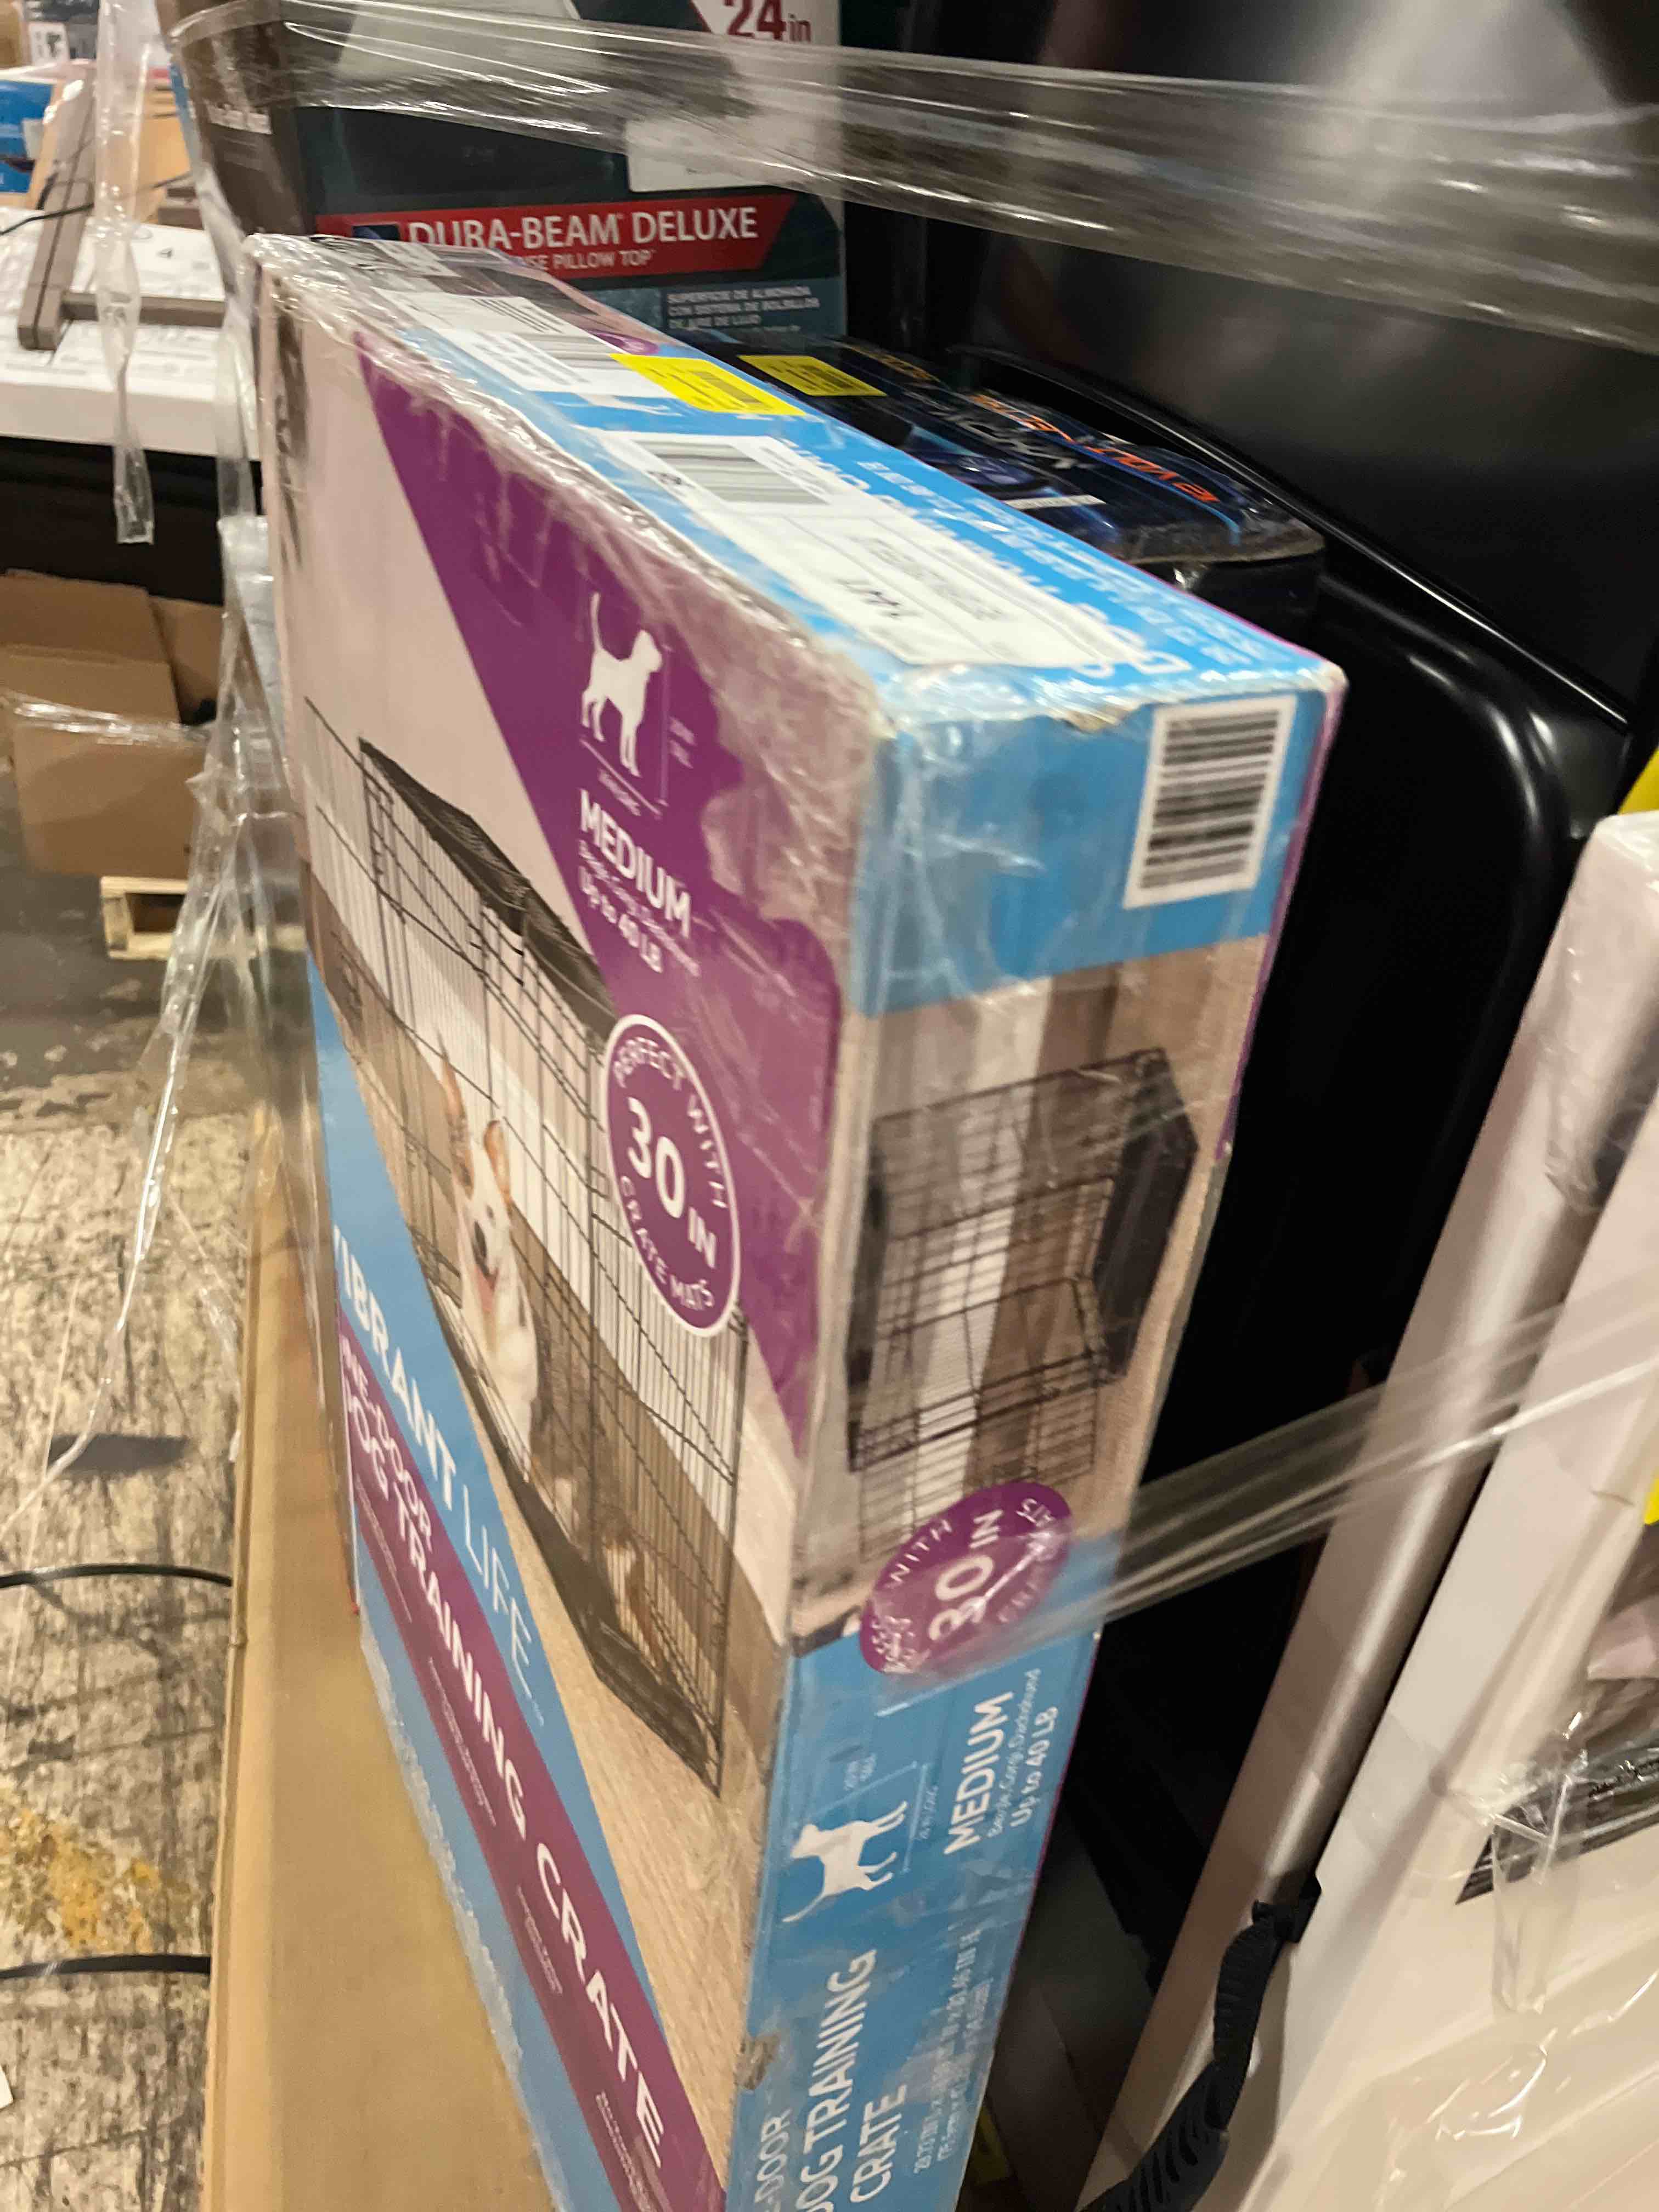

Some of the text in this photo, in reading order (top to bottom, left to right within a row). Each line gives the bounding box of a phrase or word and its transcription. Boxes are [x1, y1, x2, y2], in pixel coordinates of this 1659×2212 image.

[727, 0, 786, 40] 24
[553, 252, 616, 270] PILLOW
[618, 250, 651, 267] TOP
[631, 206, 758, 245] DELUXE
[580, 788, 691, 939] MEDIUM
[627, 1096, 686, 1218] 30
[687, 1206, 717, 1269] IN
[969, 1509, 1004, 1549] IN
[462, 1483, 532, 1700] LIFE
[393, 1481, 526, 1841] TRAINING
[537, 1843, 664, 2169] CRATE
[944, 1691, 1014, 1855] MEDIUM
[803, 1949, 878, 2155] TRAINING
[850, 2084, 908, 2204] CRATE
